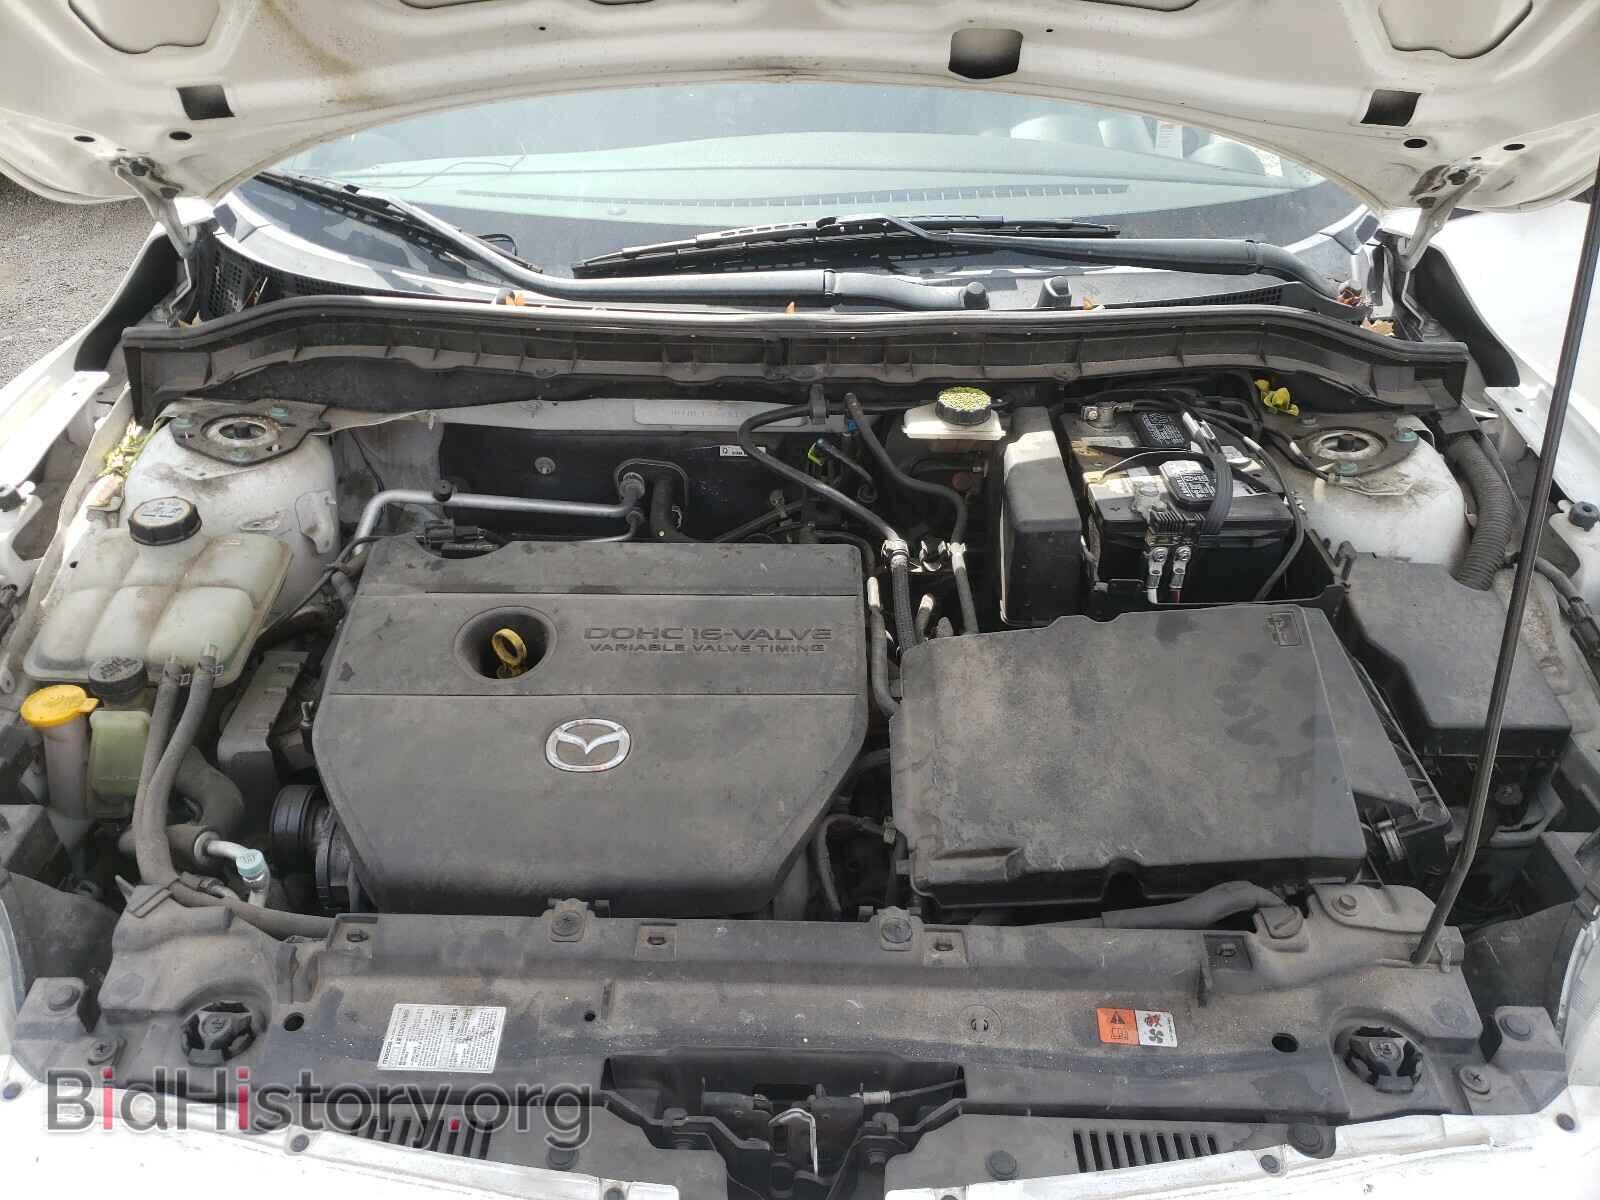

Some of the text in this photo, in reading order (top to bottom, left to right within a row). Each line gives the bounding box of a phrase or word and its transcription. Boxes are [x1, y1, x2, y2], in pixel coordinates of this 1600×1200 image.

[583, 627, 833, 641] DOHC 16-VALVE
[589, 643, 825, 653] VARIABLE VALVE TIMING
